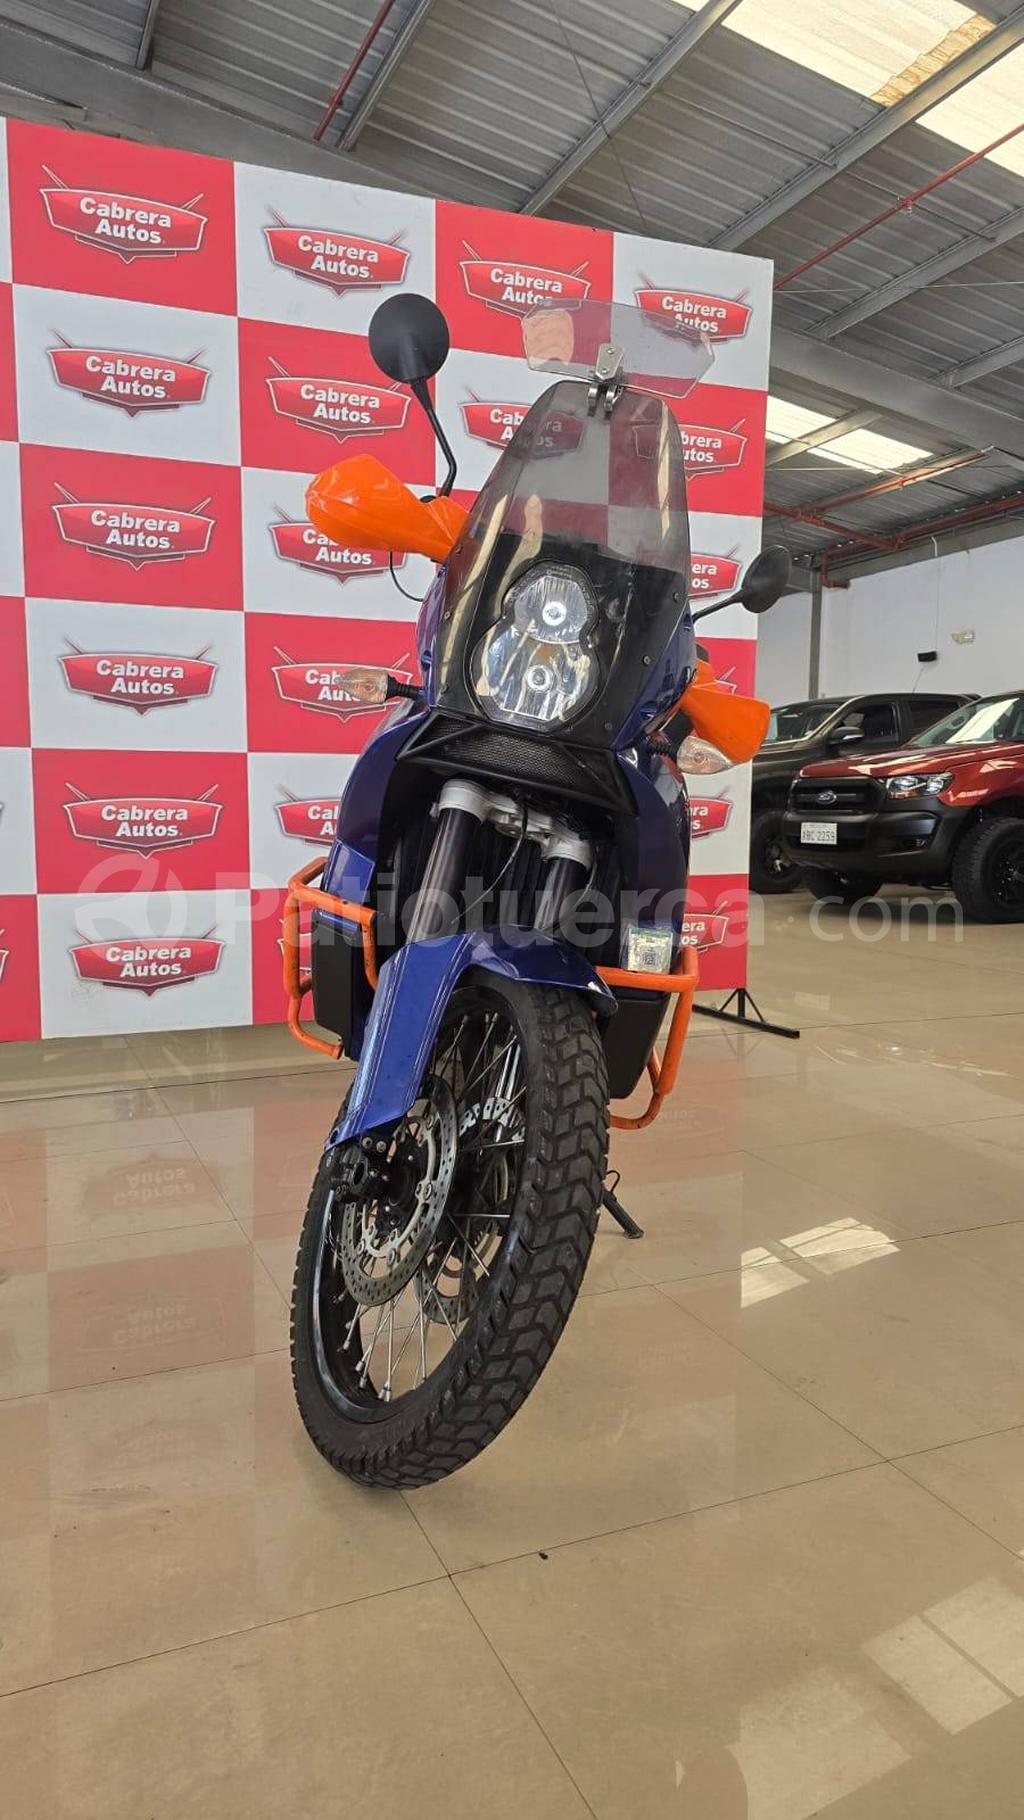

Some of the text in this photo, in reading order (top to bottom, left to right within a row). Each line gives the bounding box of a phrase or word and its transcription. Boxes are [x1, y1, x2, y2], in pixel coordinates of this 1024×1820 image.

[80, 197, 171, 228] Cabrera
[95, 220, 162, 244] Autos
[298, 235, 379, 263] Cabrera
[311, 255, 370, 278] Autos
[490, 268, 562, 293] Cabrera
[662, 296, 726, 319] Cabrera
[86, 356, 176, 382] Cabrera
[101, 376, 166, 398] Autos
[300, 384, 380, 408] Cabrera
[313, 403, 371, 424] Autos
[91, 510, 180, 533] Cabrera
[106, 529, 170, 549] Autos
[315, 547, 372, 565] Autos
[96, 660, 184, 679] Cabrera
[111, 678, 174, 694] Autos
[101, 805, 188, 821] Cabrera
[116, 822, 178, 837] Autos
[106, 947, 192, 962] Cabrera
[120, 962, 182, 978] Autos
